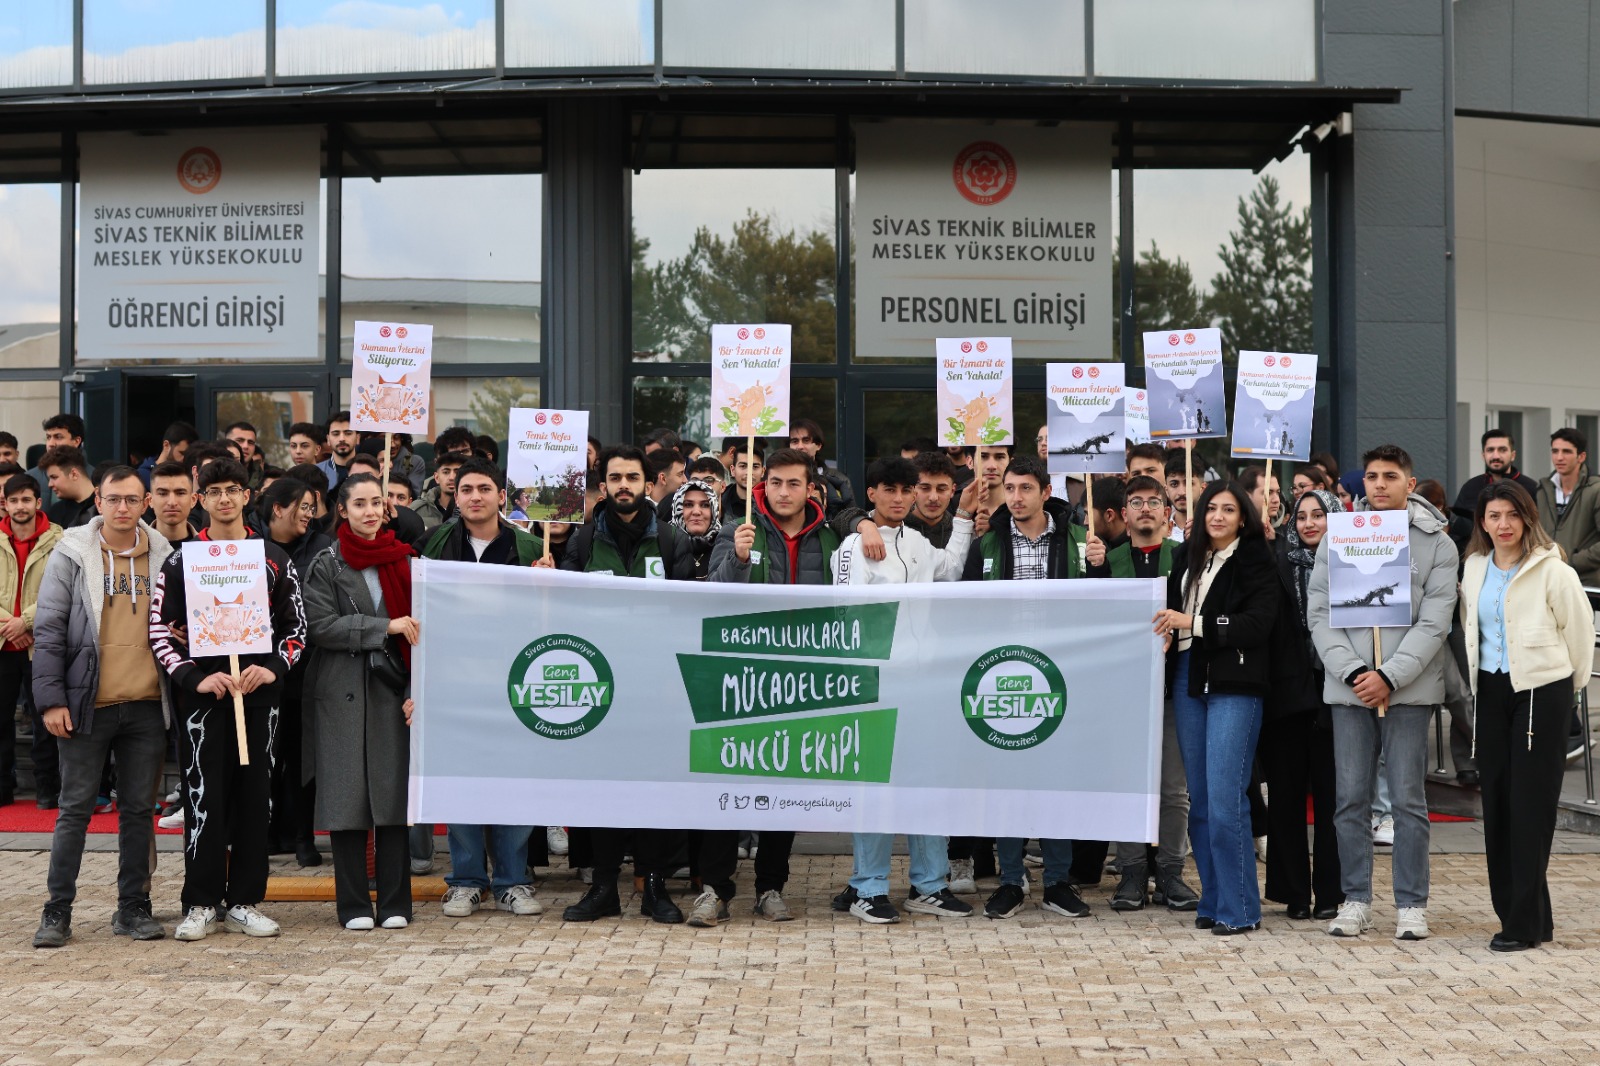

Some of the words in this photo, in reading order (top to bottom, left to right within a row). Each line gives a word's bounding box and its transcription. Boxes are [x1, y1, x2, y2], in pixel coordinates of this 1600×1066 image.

[94, 205, 132, 219] SİVAS
[135, 203, 218, 218] CUMHURİYET
[221, 201, 304, 217] ÜNİVERSİTESİ
[94, 224, 148, 244] SİVAS
[154, 221, 217, 243] TEKNİK
[224, 220, 304, 241] BİLİMLER
[872, 215, 932, 236] SİVAS
[937, 216, 1005, 238] TEKNİK
[1013, 217, 1096, 239] BİLİMLER
[93, 250, 162, 267] MESLEK
[169, 246, 303, 265] YÜKSEKOKULU
[872, 243, 947, 260] MESLEK
[955, 241, 1096, 262] YÜKSEKOKULU
[108, 296, 208, 328] ÖĞRENCİ
[215, 295, 285, 333] GİRİŞİ
[881, 296, 1007, 324] PERSONEL
[1013, 292, 1086, 331] GİRİŞİ
[361, 343, 397, 354] Dumanın
[397, 342, 426, 355] İzlerini
[718, 345, 734, 357] Bir
[734, 343, 770, 357] İzmarit
[771, 345, 784, 356] de
[367, 353, 417, 368] Siliyoruz.
[721, 358, 740, 370] Sen
[740, 357, 781, 370] Yakala!
[942, 357, 958, 369] Bir
[958, 355, 993, 369] İzmarit
[994, 357, 1006, 368] de
[1188, 358, 1217, 368] Toplama
[946, 370, 963, 382] Sen
[964, 369, 1003, 382] Yakala!
[1051, 384, 1088, 394] Dumanın
[1088, 382, 1122, 396] İzleriyle
[1281, 381, 1310, 391] Toplama
[1062, 395, 1111, 406] Mücadele
[525, 430, 549, 440] Temiz
[550, 431, 572, 441] Nefes
[517, 440, 542, 451] Temiz
[543, 441, 579, 454] Kampüs
[1330, 534, 1370, 545] Dumanın
[1371, 531, 1406, 545] İzleriyle
[1343, 545, 1395, 557] Mücadele
[190, 563, 228, 573] Dumanın
[229, 560, 260, 571] İzlerini
[199, 573, 252, 588] Siliyoruz.
[720, 617, 862, 650] BAĞIMLILIKLARLA
[524, 641, 547, 660] Sivas
[546, 637, 597, 659] Cumhuriyet
[978, 652, 999, 671] Sivas
[999, 648, 1050, 669] Cumhuriyet
[544, 664, 578, 680] Genç
[721, 666, 862, 715] MÜCADELEDE
[996, 676, 1031, 691] Genç
[512, 683, 609, 709] YEŞİLAY
[965, 694, 1061, 721] YEŞİLAY
[534, 720, 586, 737] Üniversitesi
[719, 729, 790, 773] ÖNCÜ
[800, 719, 861, 775] EKİP!
[987, 731, 1039, 748] Üniversitesi
